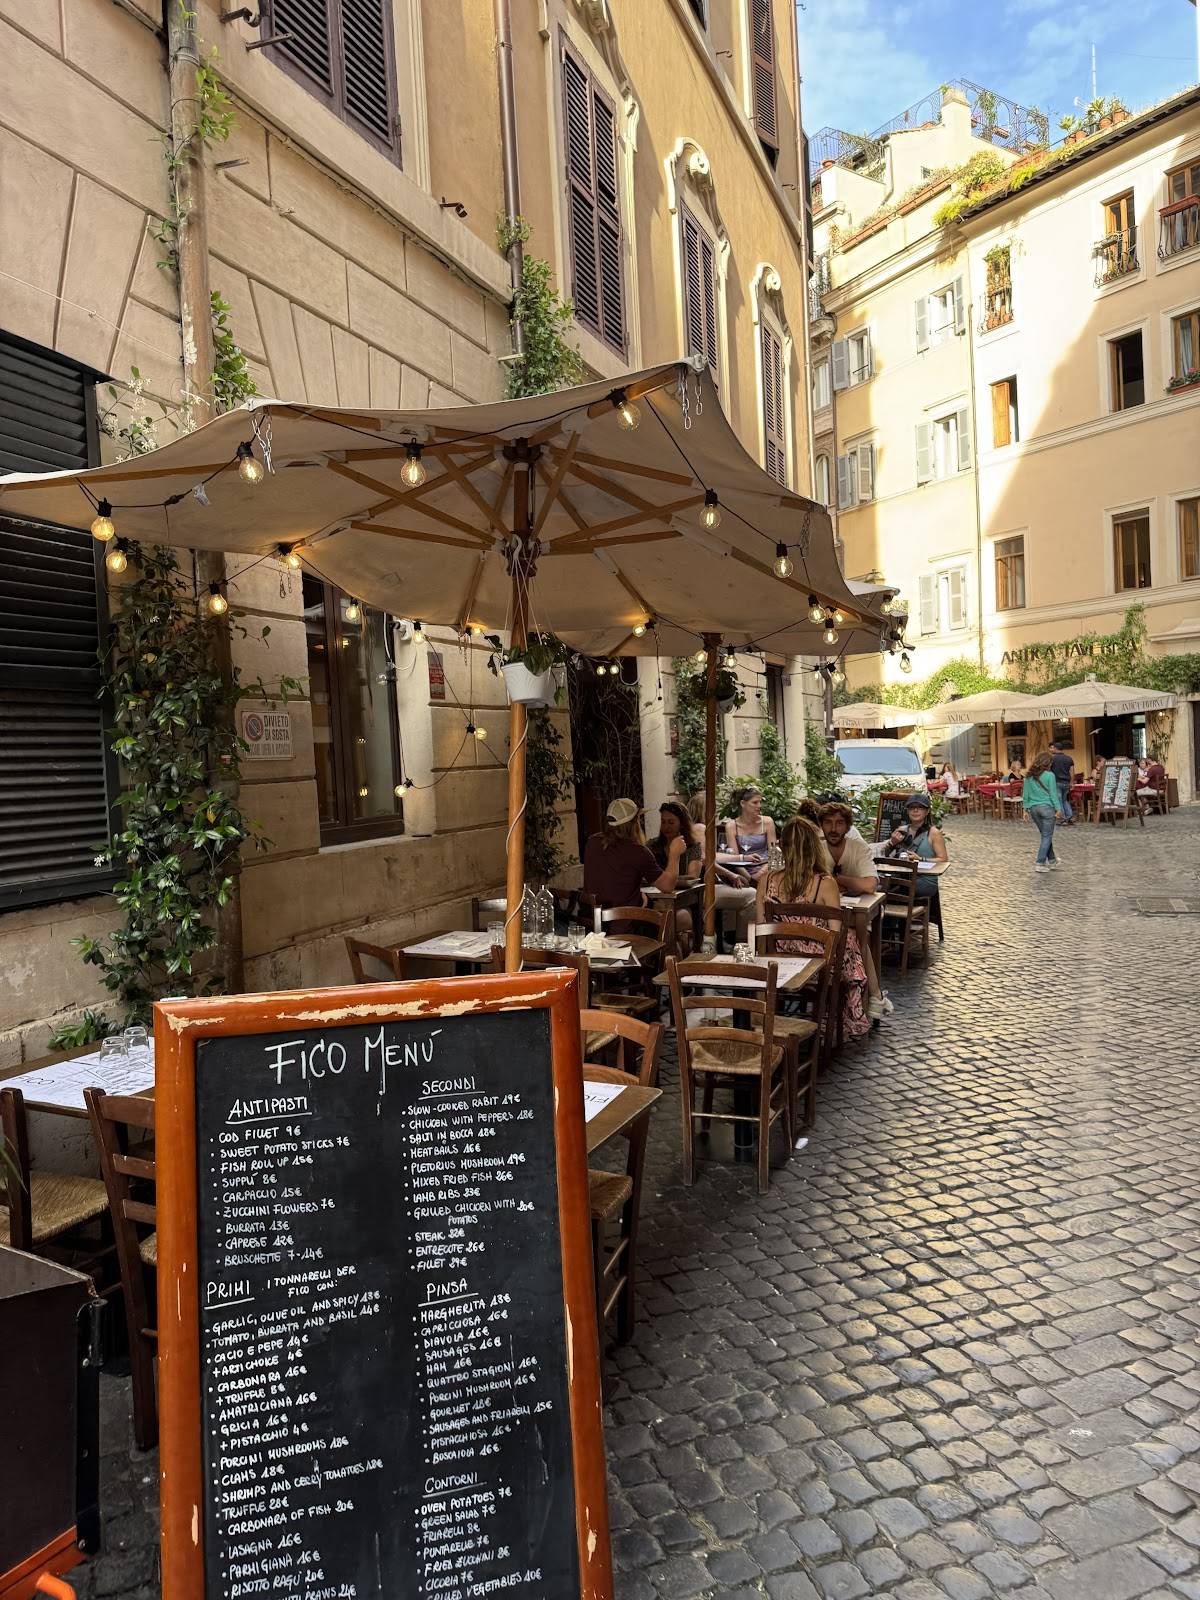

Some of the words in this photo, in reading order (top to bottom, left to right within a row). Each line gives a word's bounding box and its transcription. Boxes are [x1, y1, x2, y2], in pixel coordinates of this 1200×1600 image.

[264, 715, 288, 727] DIVIETO
[272, 729, 290, 741] SOSTA
[264, 1039, 346, 1084] FICO
[422, 1076, 476, 1095] SECONDI
[228, 1097, 308, 1120] ANTIPASTI
[471, 1096, 499, 1109] RABIT
[409, 1117, 448, 1130] CHICKEN
[451, 1114, 474, 1125] WITH
[478, 1110, 514, 1122] PEPPERS
[219, 1132, 239, 1143] COD
[245, 1127, 279, 1140] FILLET
[437, 1130, 447, 1139] IN
[449, 1127, 474, 1140] BOCCA
[220, 1146, 259, 1158] SWEET
[264, 1142, 298, 1154] POTATO
[302, 1139, 334, 1150] STICKS
[220, 1161, 246, 1174] FISH
[251, 1158, 274, 1170] ROLL
[277, 1157, 289, 1167] UP
[412, 1176, 441, 1189] MIXED
[443, 1173, 469, 1185] FRIED
[471, 1171, 493, 1182] FISH
[222, 1189, 277, 1203] CARPACCIO
[412, 1190, 436, 1204] LAMB
[438, 1188, 461, 1200] RIBS
[223, 1205, 270, 1218] ZUCCHINI
[273, 1202, 318, 1215] FLOWERS
[413, 1205, 451, 1220] GRILLED
[454, 1201, 492, 1213] CHICKEN
[493, 1198, 516, 1209] WITH
[225, 1222, 265, 1234] BURRATA
[414, 1231, 445, 1242] STEAK
[225, 1237, 267, 1250] CAPRESE
[416, 1258, 446, 1272] FILLET
[274, 1269, 331, 1285] TONNARELLI
[337, 1265, 356, 1276] DER
[207, 1280, 250, 1303] PRIMI
[288, 1286, 309, 1298] FICO
[426, 1278, 468, 1302] PINSA
[260, 1309, 288, 1323] OLIVE
[290, 1306, 306, 1316] OIL
[312, 1300, 331, 1312] AND
[333, 1294, 358, 1307] SPICY
[420, 1298, 486, 1323] MARGHERITA
[257, 1322, 300, 1337] BURRATA
[303, 1316, 324, 1328] AND
[329, 1309, 357, 1323] BASIL
[424, 1331, 464, 1349] DIAVOLA
[214, 1350, 244, 1364] CACIO
[247, 1346, 255, 1356] E
[257, 1339, 284, 1354] PEPE
[426, 1361, 447, 1374] HAM
[217, 1372, 281, 1392] CARBONARA
[426, 1371, 469, 1388] QUATTRO
[429, 1388, 462, 1405] PORCINI
[219, 1396, 293, 1422] AMATRICIANA
[429, 1402, 470, 1421] GOURMET
[220, 1419, 259, 1436] GRICIA
[471, 1413, 489, 1425] AND
[220, 1452, 262, 1470] PORCINI
[268, 1439, 326, 1460] MUSHROOMS
[221, 1470, 256, 1487] CLAMS
[222, 1485, 266, 1503] SHRIMPS
[270, 1480, 291, 1493] AND
[325, 1464, 365, 1480] TOMATOES
[424, 1472, 478, 1494] CONTORNI
[221, 1502, 266, 1520] TRUFFLE
[420, 1501, 446, 1516] OVEN
[450, 1491, 495, 1509] POTATOES
[227, 1513, 287, 1535] CARBONARA
[291, 1509, 304, 1520] OF
[309, 1504, 330, 1516] FISH
[454, 1508, 479, 1522] SALAD
[229, 1538, 273, 1559] LASAGNA
[425, 1574, 458, 1592] CICORIA
